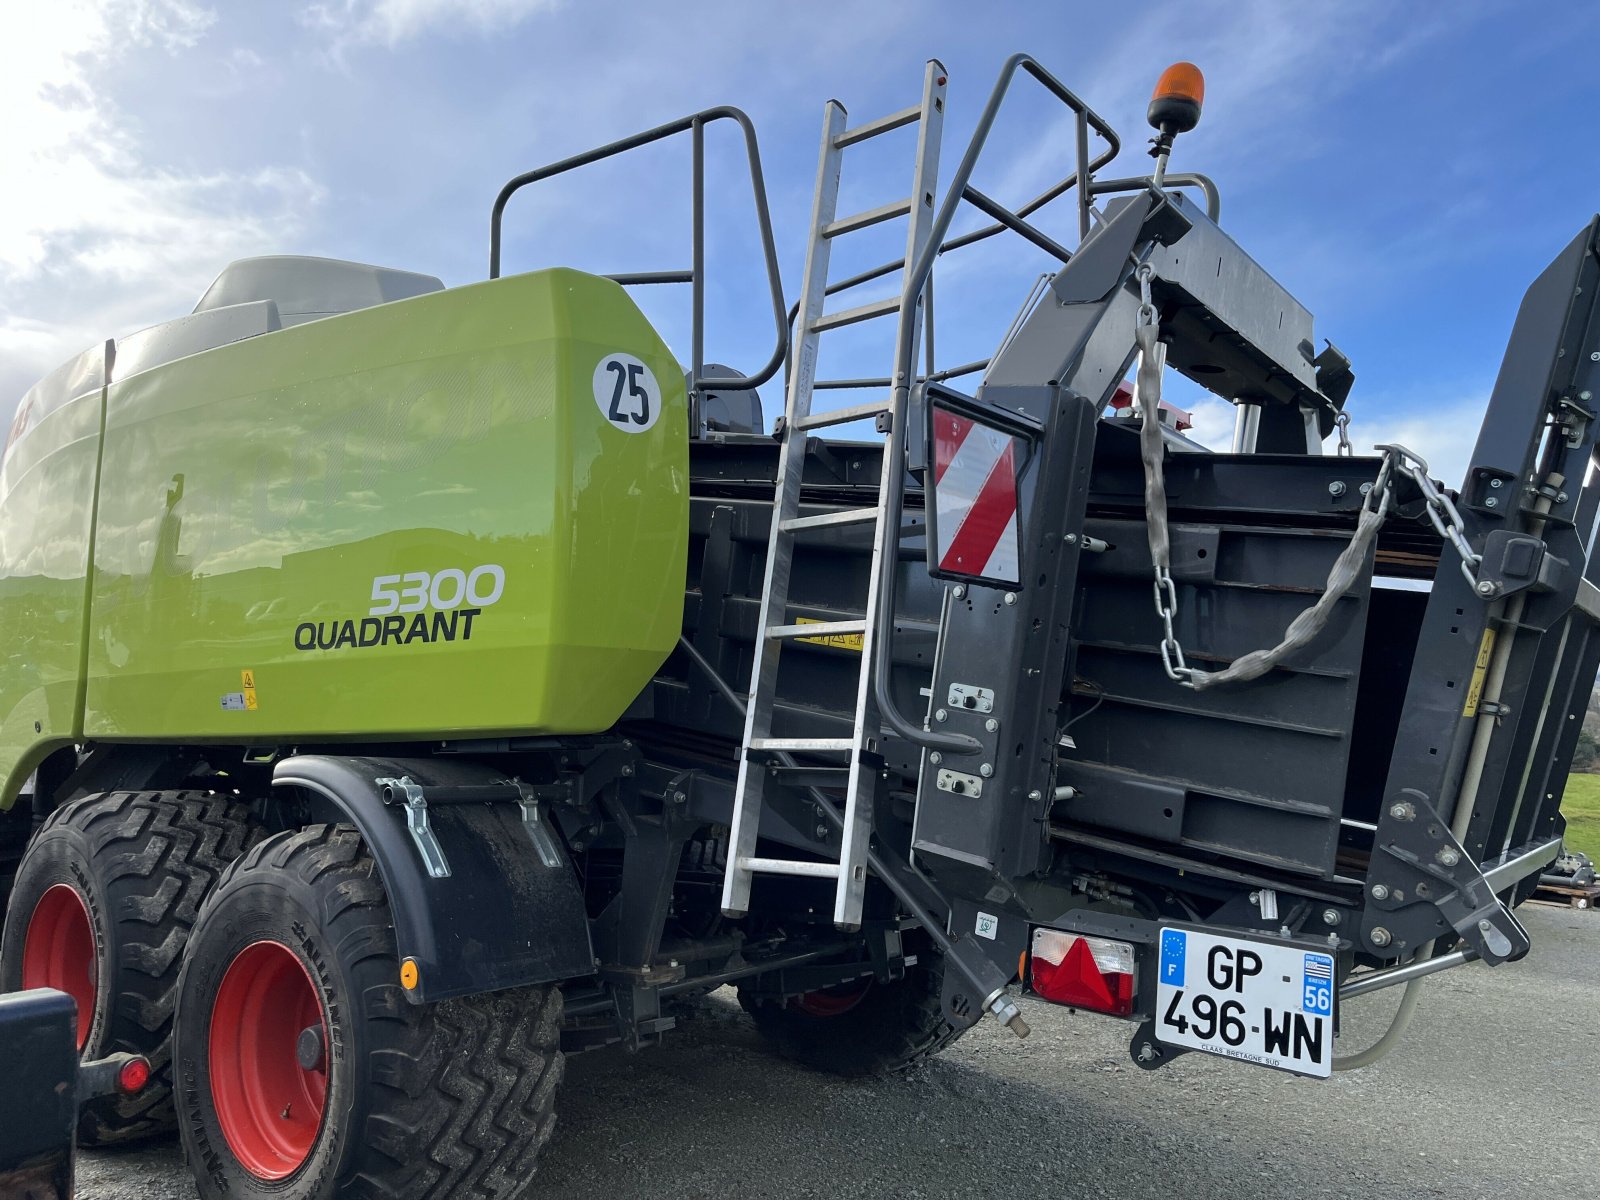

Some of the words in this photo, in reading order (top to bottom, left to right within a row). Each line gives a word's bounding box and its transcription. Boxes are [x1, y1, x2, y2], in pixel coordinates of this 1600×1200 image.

[606, 360, 650, 426] 25
[369, 563, 505, 617] 5300
[294, 608, 481, 651] QUADRANT
[1167, 964, 1177, 977] F
[1207, 945, 1263, 994] GP
[301, 934, 345, 1061] ALLIANCE
[1304, 986, 1330, 1011] 56
[1163, 990, 1323, 1065] 496-WN
[1201, 1044, 1223, 1053] CLAAS
[1226, 1049, 1262, 1063] BRETAGNE
[1265, 1058, 1280, 1067] SUD
